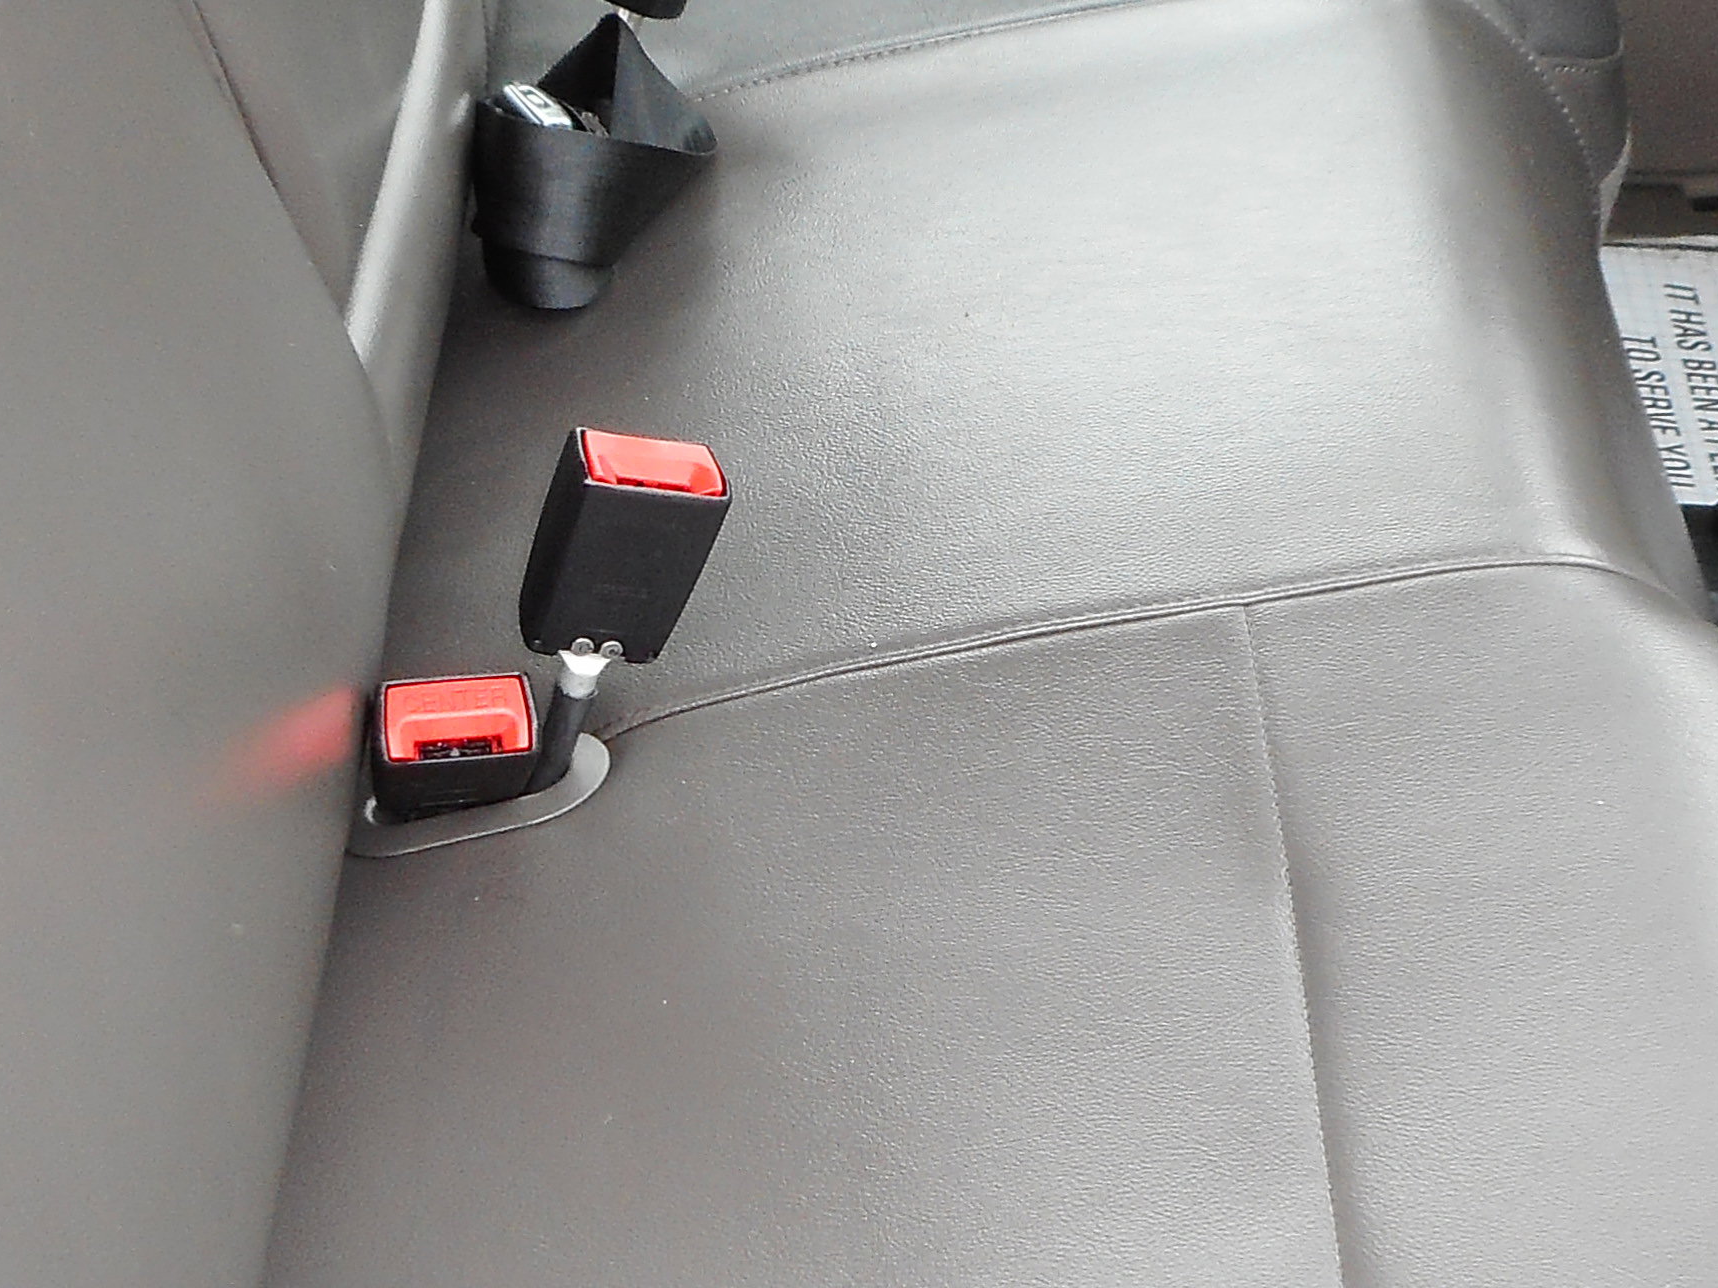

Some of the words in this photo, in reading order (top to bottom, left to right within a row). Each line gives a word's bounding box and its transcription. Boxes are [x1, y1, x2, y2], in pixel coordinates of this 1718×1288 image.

[1663, 282, 1701, 305] IT
[1621, 335, 1662, 363] TO
[1668, 308, 1714, 353] HAS
[1633, 368, 1682, 438] SERVE
[1657, 443, 1696, 489] YOU
[402, 685, 508, 714] CENTER
